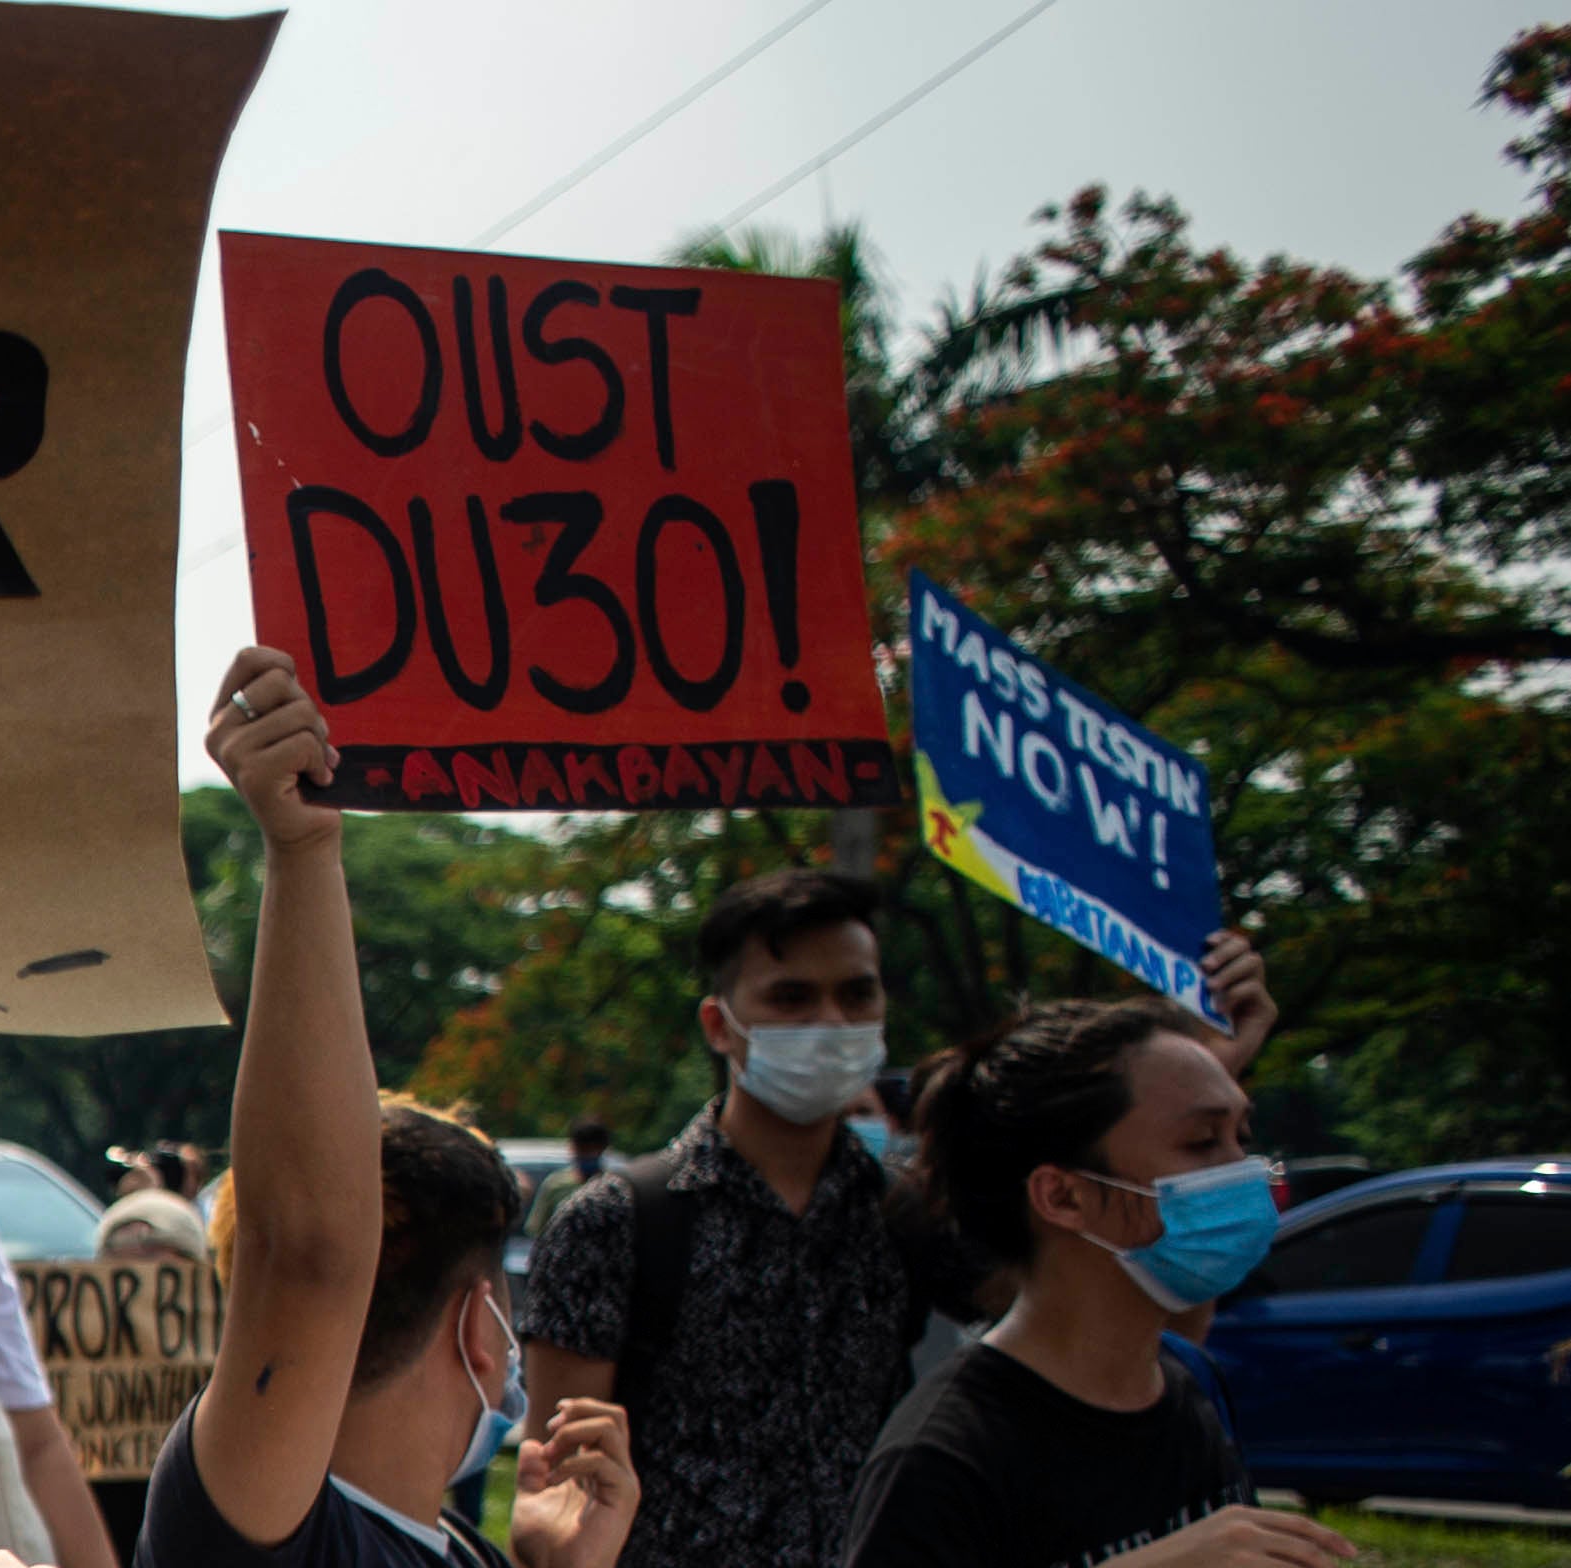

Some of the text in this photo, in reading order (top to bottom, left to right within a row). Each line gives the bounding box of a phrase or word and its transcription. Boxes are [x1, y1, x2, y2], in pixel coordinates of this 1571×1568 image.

[322, 267, 702, 472] OUST
[285, 479, 811, 715] DU30!
[920, 588, 1053, 721] MASS
